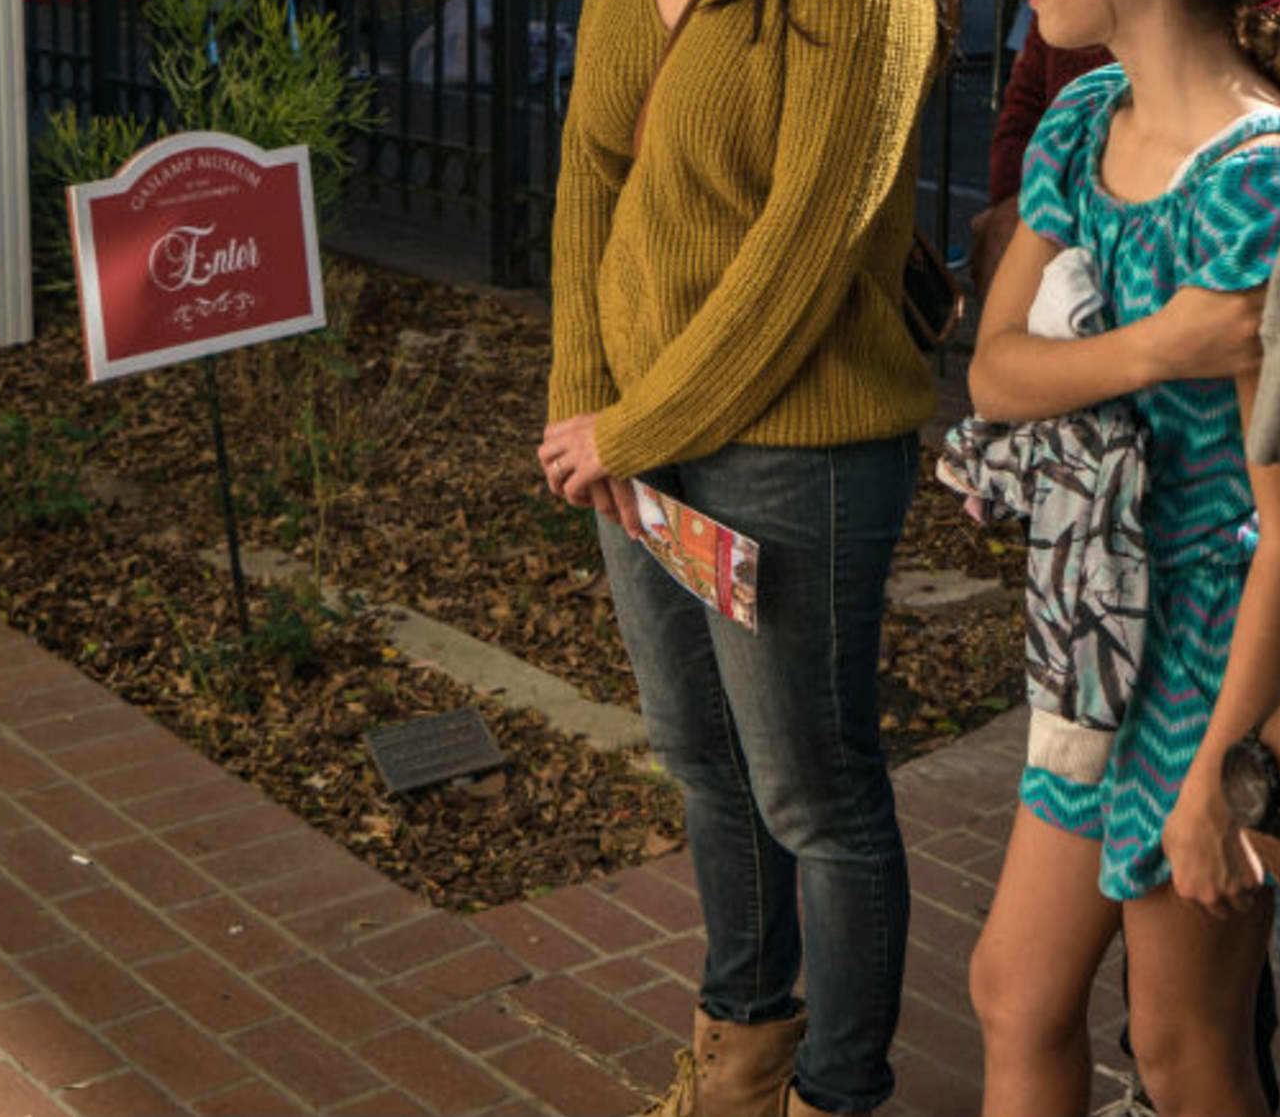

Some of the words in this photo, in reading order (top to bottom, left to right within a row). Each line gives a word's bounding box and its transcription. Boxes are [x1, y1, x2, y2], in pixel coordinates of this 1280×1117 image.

[130, 156, 193, 211] GASLAMP
[197, 153, 261, 189] MUSEUM
[148, 222, 261, 292] Enter
